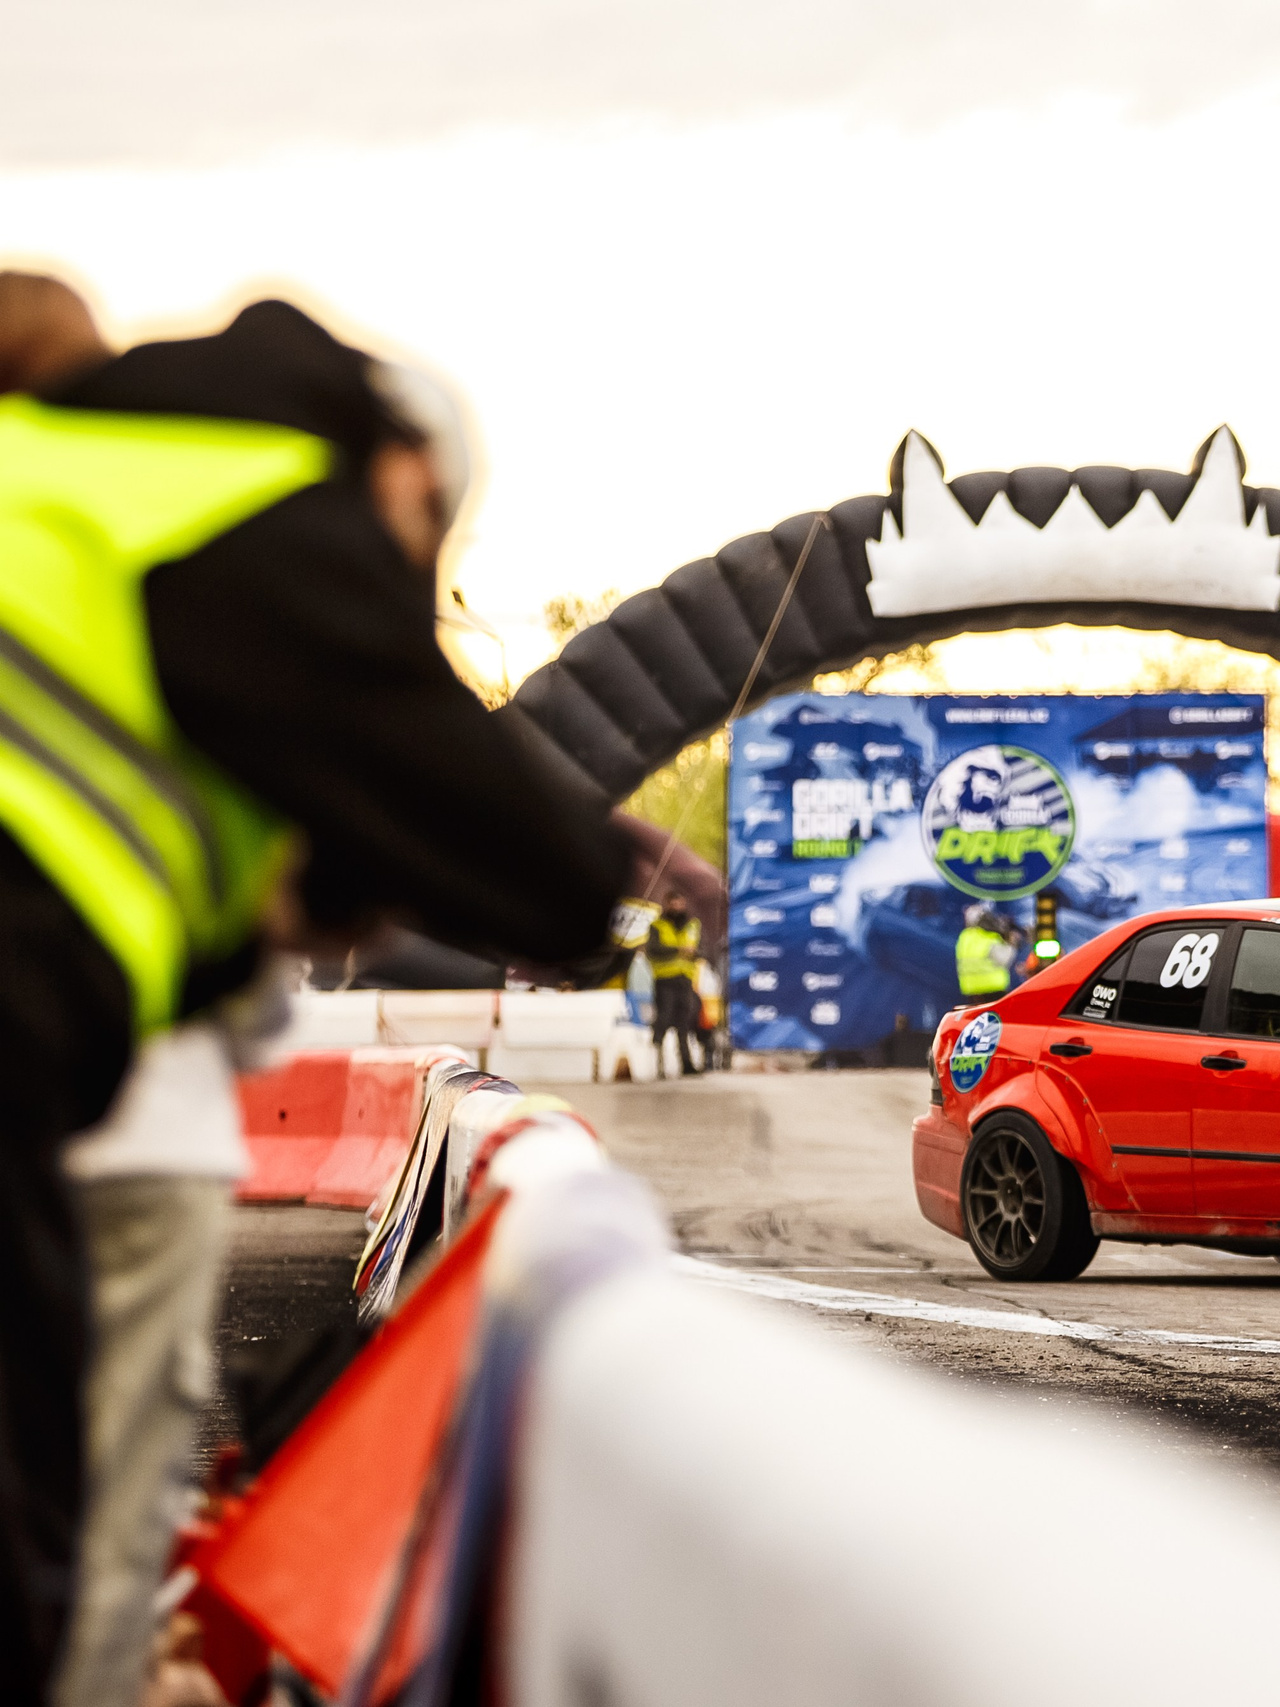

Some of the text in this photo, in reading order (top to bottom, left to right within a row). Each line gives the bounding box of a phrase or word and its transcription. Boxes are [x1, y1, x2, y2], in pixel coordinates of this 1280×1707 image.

[792, 779, 913, 811] GORILLA
[1159, 932, 1220, 989] 68
[1092, 984, 1117, 1001] OWO
